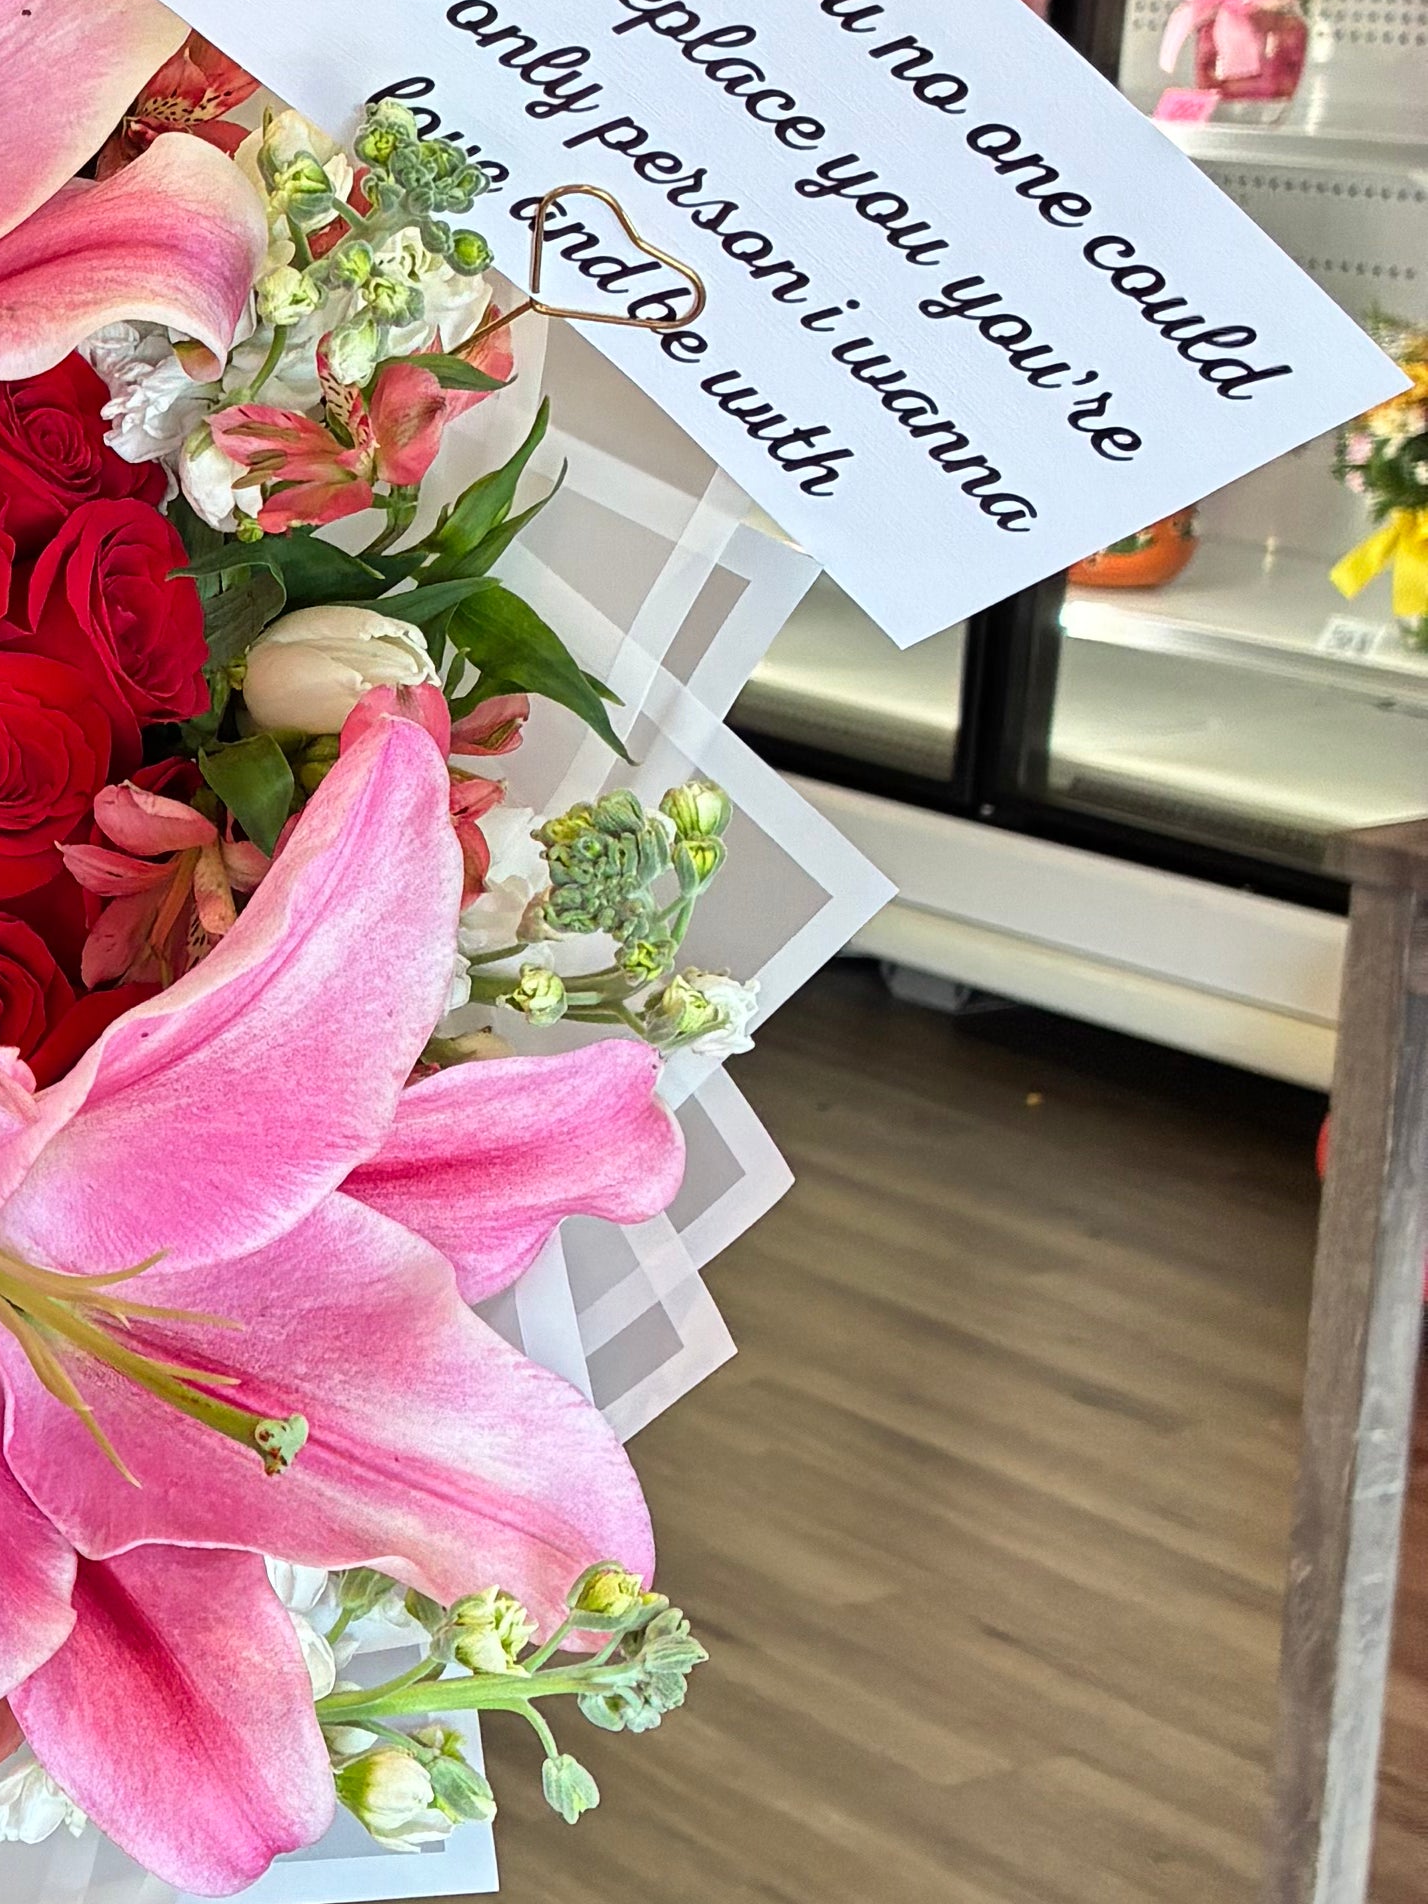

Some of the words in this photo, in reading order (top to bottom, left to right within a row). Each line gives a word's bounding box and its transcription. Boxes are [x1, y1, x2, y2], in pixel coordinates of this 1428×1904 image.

[509, 196, 663, 294] and
[626, 286, 709, 364] be
[562, 116, 810, 304] person
[800, 299, 860, 332] i
[831, 337, 1038, 532] wanna
[794, 153, 949, 266] you
[918, 275, 1142, 462] you're
[868, 35, 969, 114] no
[966, 123, 1092, 228] one
[1083, 235, 1293, 400] could
